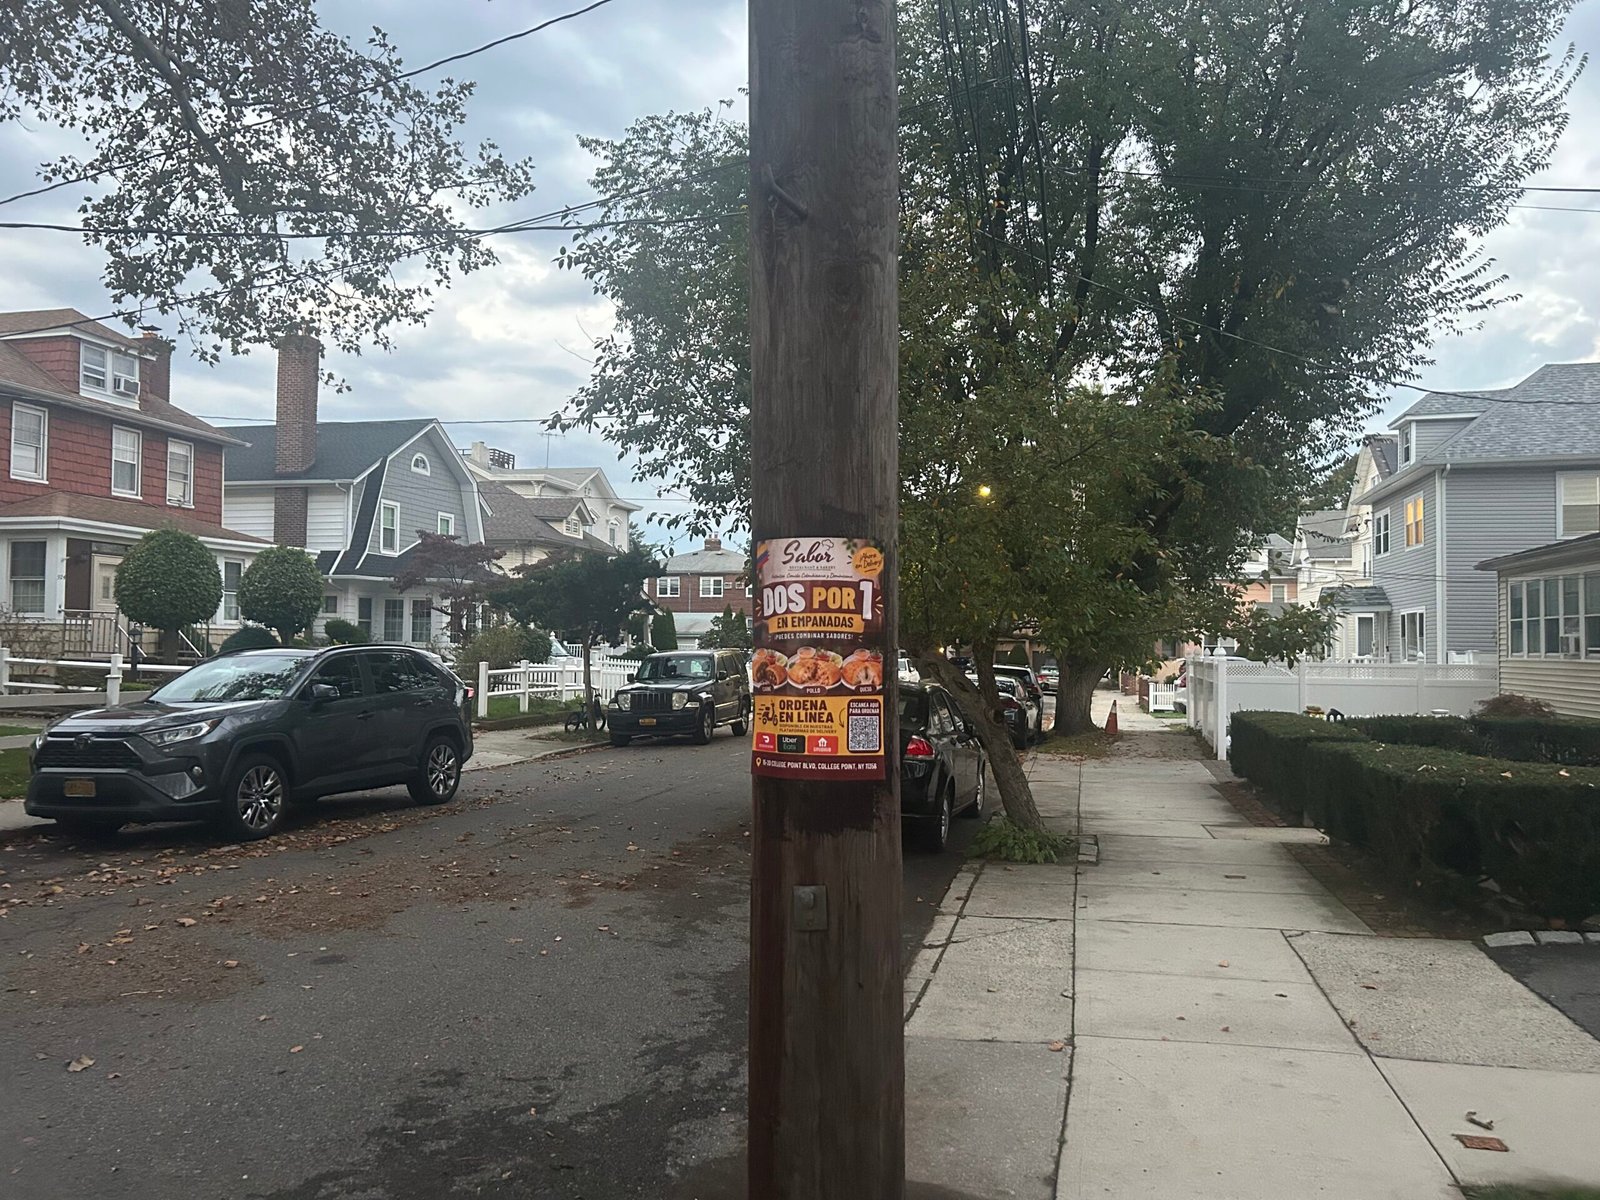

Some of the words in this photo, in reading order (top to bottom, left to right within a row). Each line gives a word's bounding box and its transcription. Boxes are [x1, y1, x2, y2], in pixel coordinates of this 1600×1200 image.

[782, 539, 834, 565] Sabor
[763, 583, 806, 617] DOS
[812, 586, 856, 609] POR
[859, 580, 873, 620] 1
[777, 617, 788, 628] EN
[791, 616, 854, 628] EMPANADAS
[796, 632, 825, 640] COMBINAR
[779, 699, 828, 711] ORDENA
[779, 712, 794, 722] EN
[787, 761, 802, 769] POINT
